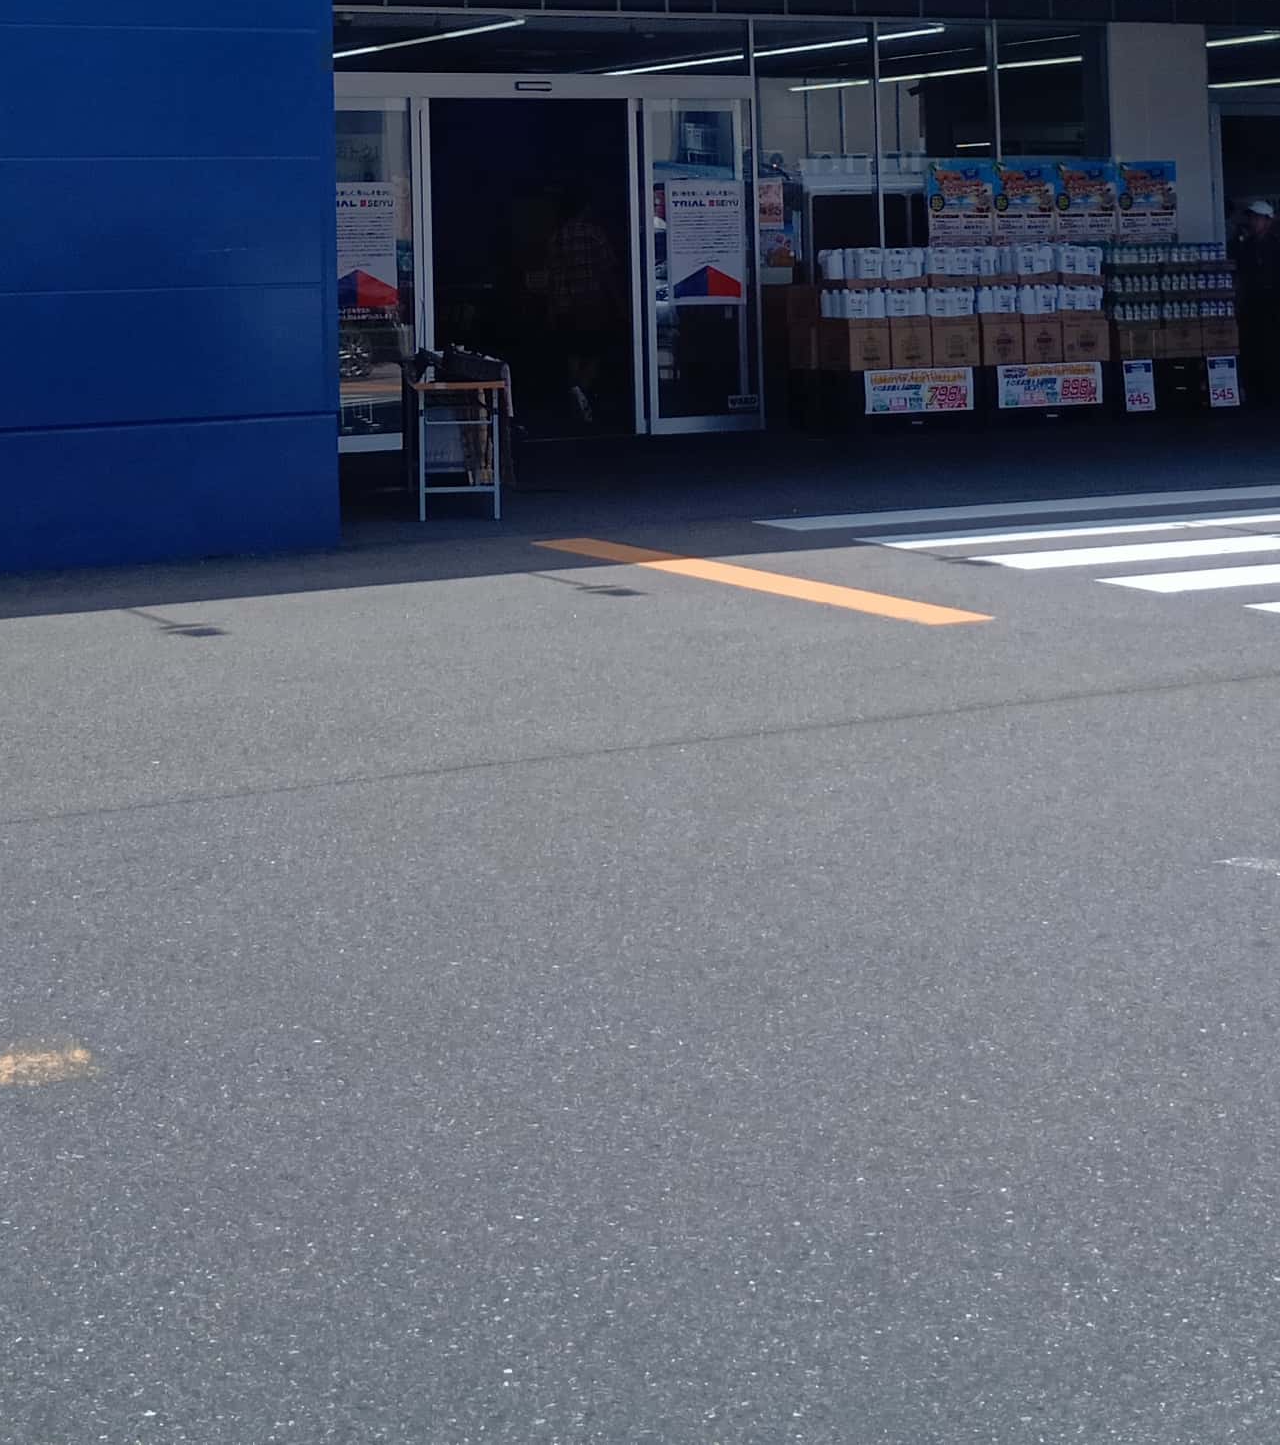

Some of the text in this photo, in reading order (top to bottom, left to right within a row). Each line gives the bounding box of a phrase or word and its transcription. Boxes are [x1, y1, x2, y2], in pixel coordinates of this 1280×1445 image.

[367, 199, 393, 208] SEIYU
[671, 199, 739, 208] TRIAL SEIYU
[1127, 392, 1151, 406] 445
[1212, 387, 1234, 401] 545
